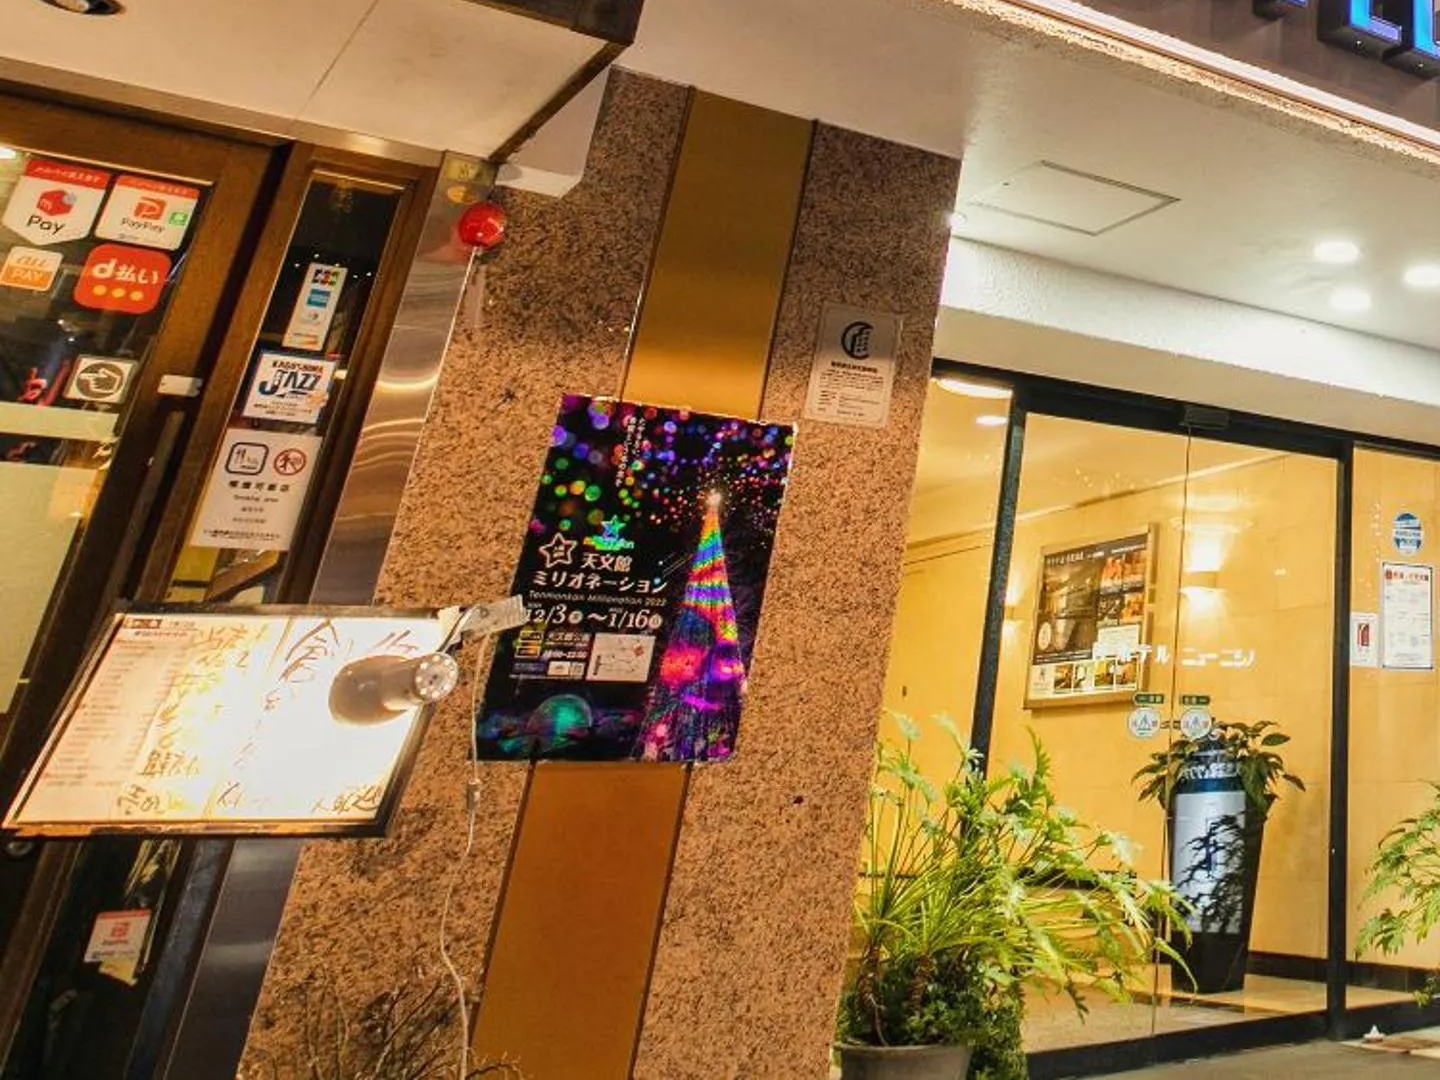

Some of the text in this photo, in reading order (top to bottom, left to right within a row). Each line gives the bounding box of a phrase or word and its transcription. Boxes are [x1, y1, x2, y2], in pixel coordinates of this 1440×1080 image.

[27, 214, 67, 236] Pay
[91, 258, 160, 285] d払い
[581, 553, 633, 573] 天文館
[532, 570, 668, 595] ミリオネーション
